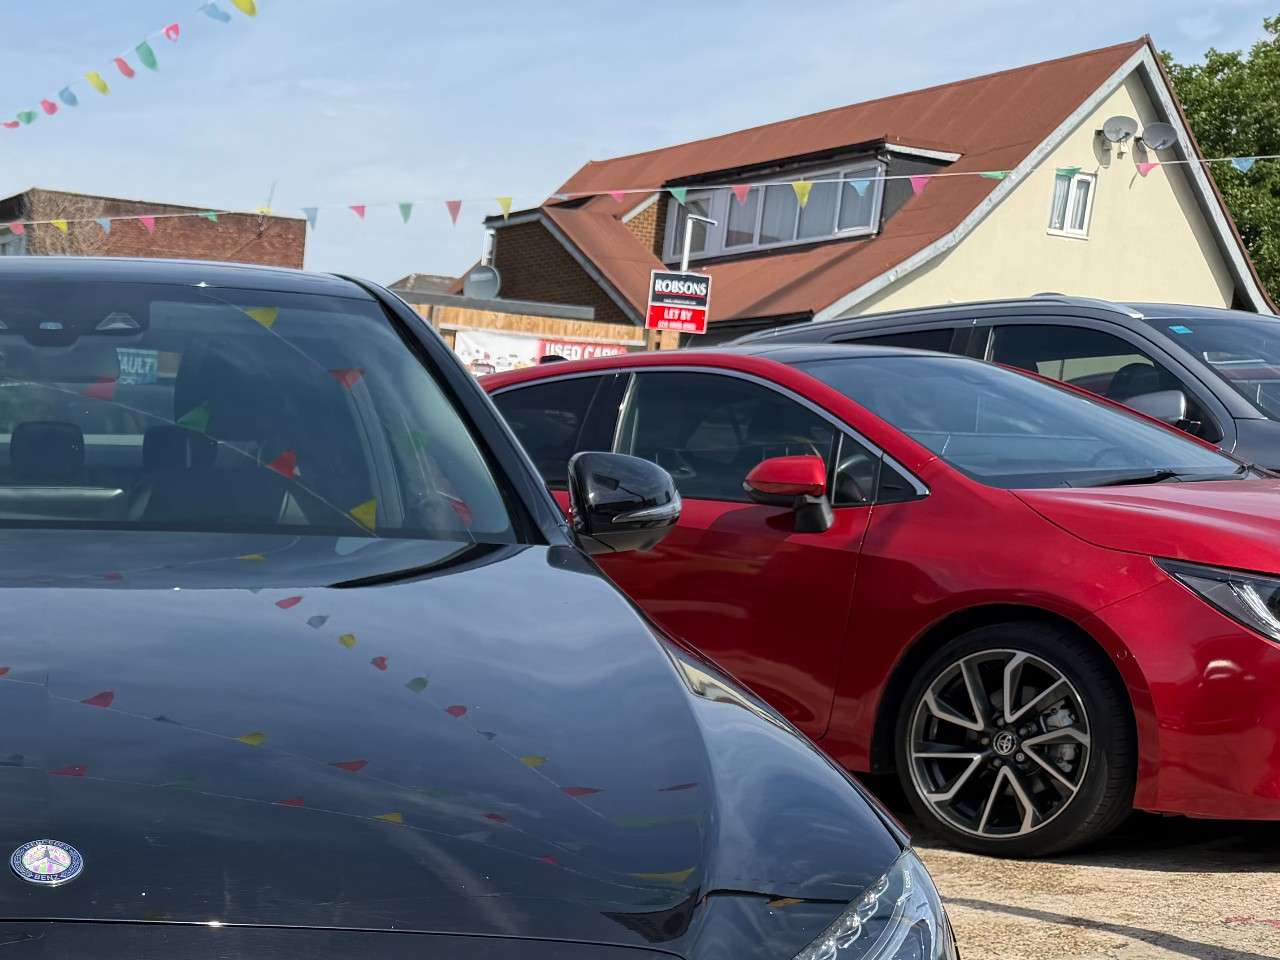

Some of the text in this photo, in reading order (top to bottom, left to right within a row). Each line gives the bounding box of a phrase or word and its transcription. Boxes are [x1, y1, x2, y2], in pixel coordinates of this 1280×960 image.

[655, 279, 707, 296] ROBSONS
[663, 307, 693, 321] LET BY
[545, 342, 581, 361] USED
